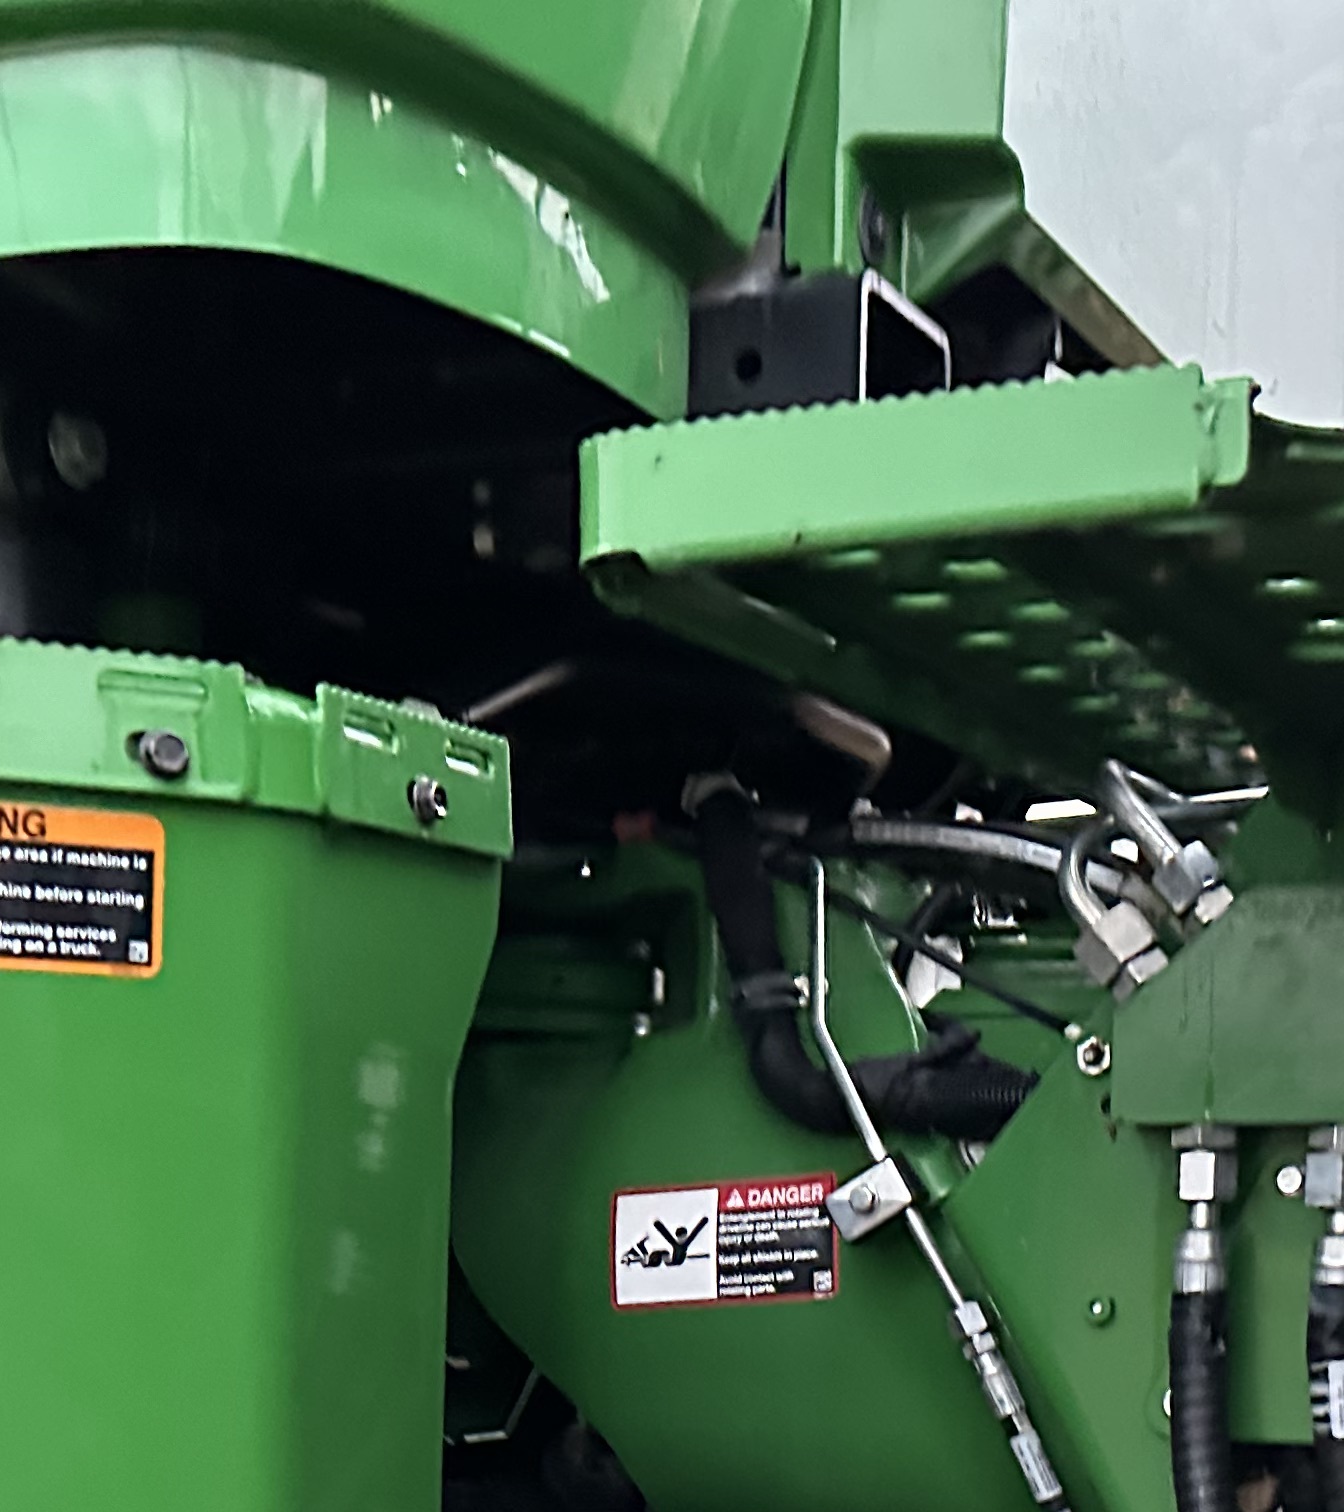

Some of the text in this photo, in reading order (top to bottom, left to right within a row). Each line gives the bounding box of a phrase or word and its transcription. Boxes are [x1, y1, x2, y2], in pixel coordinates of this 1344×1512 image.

[14, 847, 48, 862] area
[66, 850, 130, 870] machine
[35, 884, 83, 903] before
[87, 890, 144, 911] starting
[747, 1183, 824, 1207] DANGER
